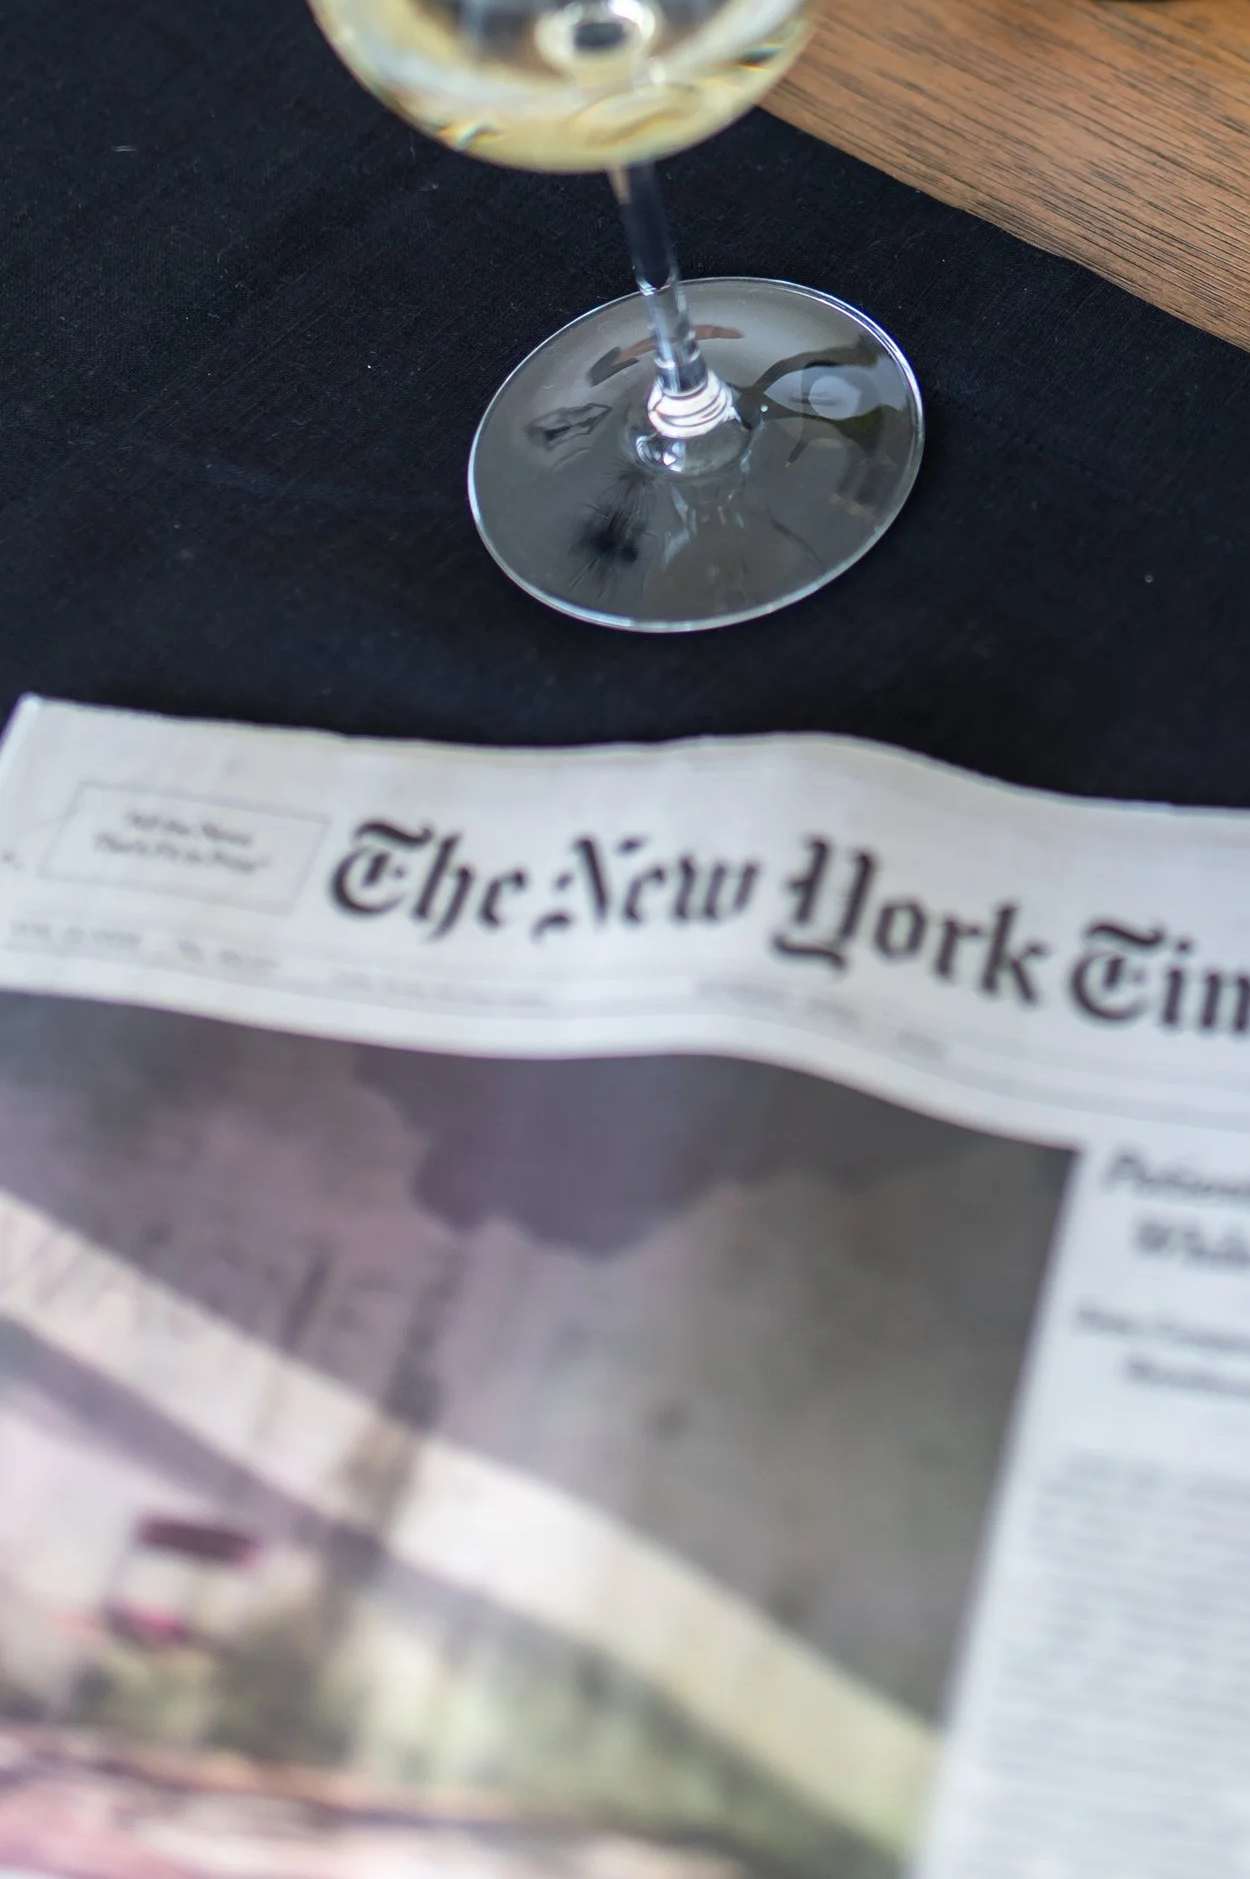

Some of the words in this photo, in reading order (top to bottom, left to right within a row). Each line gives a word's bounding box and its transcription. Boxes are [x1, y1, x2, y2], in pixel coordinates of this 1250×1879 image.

[329, 819, 531, 942] The
[532, 831, 764, 943] New
[769, 836, 1050, 1008] York
